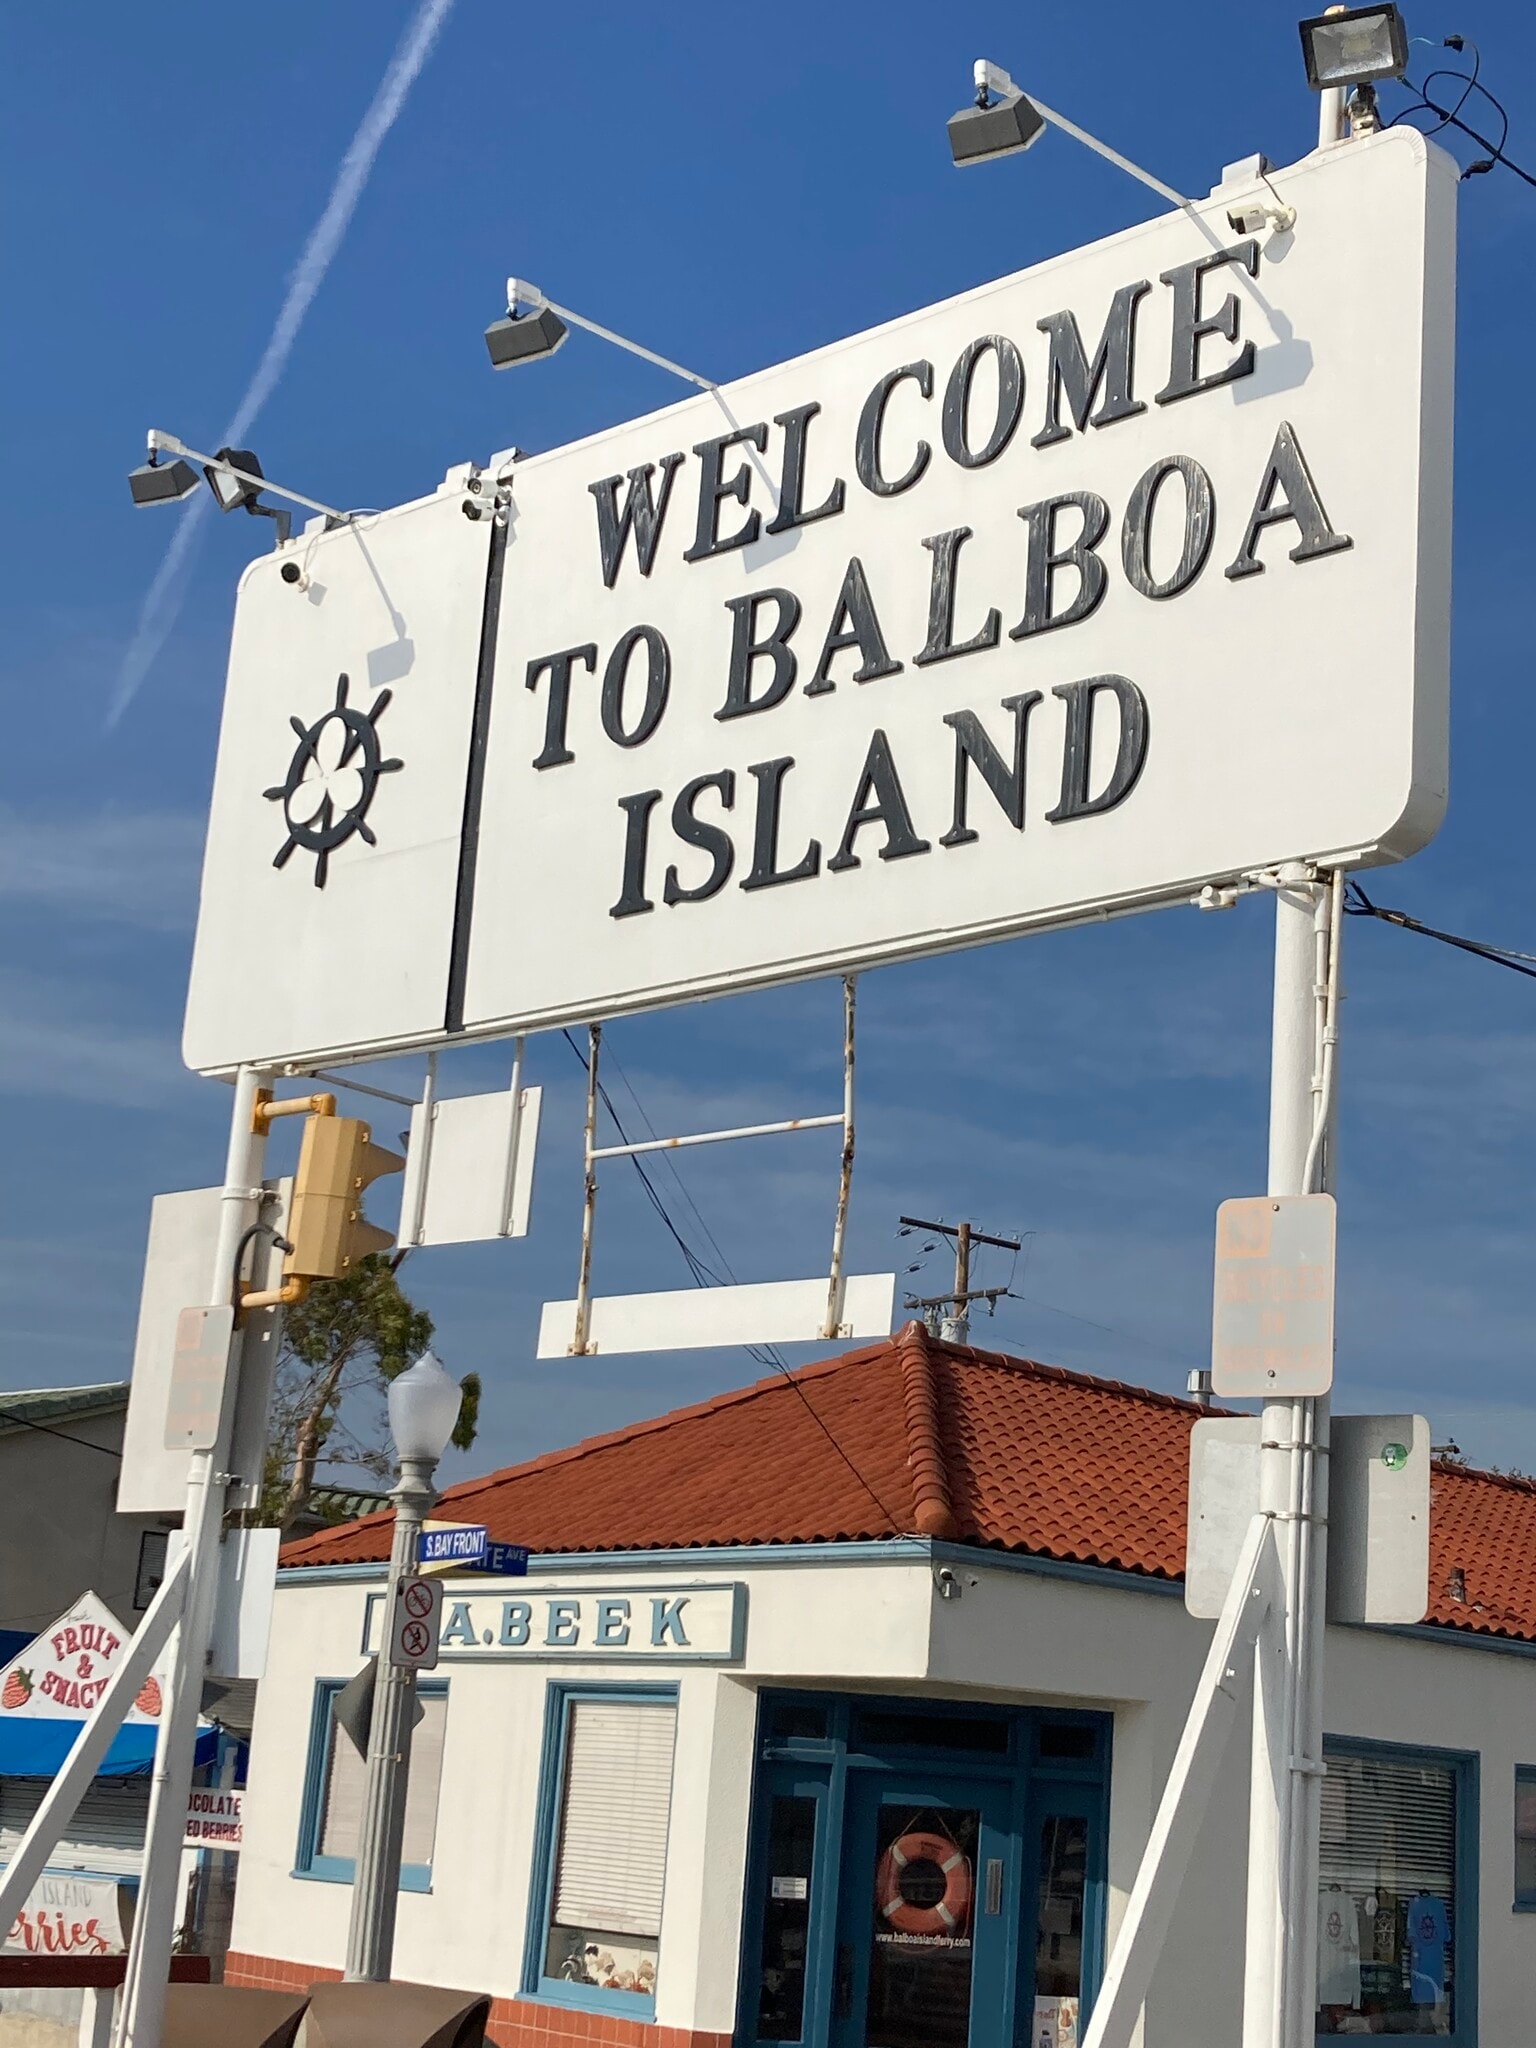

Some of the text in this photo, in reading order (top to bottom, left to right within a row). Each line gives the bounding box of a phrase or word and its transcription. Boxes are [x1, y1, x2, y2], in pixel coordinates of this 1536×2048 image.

[586, 238, 1261, 590] WELCOME
[524, 420, 1354, 770] TO BALBOA
[609, 672, 1150, 920] ISLAND
[453, 1531, 486, 1554] FRONT
[506, 1548, 526, 1561] AVE
[50, 1624, 121, 1661] FRUIT
[77, 1653, 94, 1679] &
[202, 1820, 243, 1842] BERRIES
[42, 1881, 92, 1908] ISLAND
